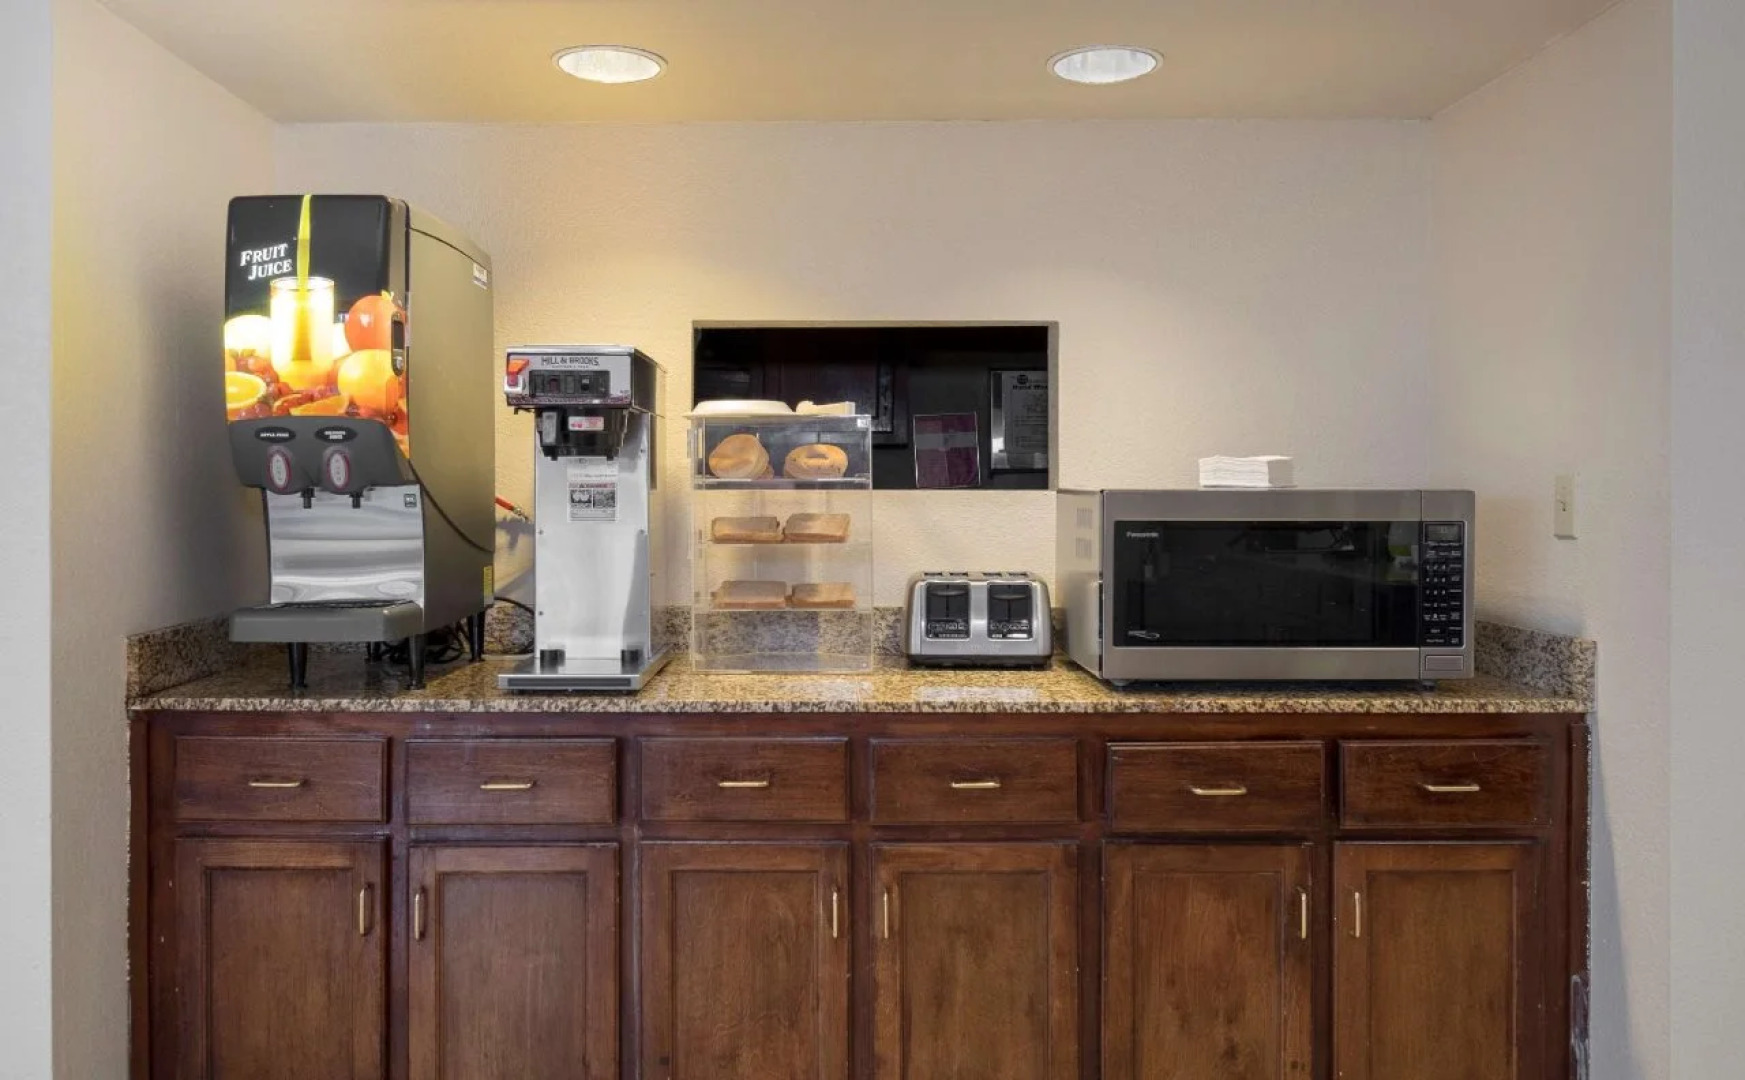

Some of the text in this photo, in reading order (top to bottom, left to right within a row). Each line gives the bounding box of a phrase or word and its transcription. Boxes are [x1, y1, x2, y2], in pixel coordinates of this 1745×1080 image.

[240, 243, 288, 266] FRUIT
[248, 259, 293, 280] JUICE
[541, 356, 600, 366] HILL & BROOKS
